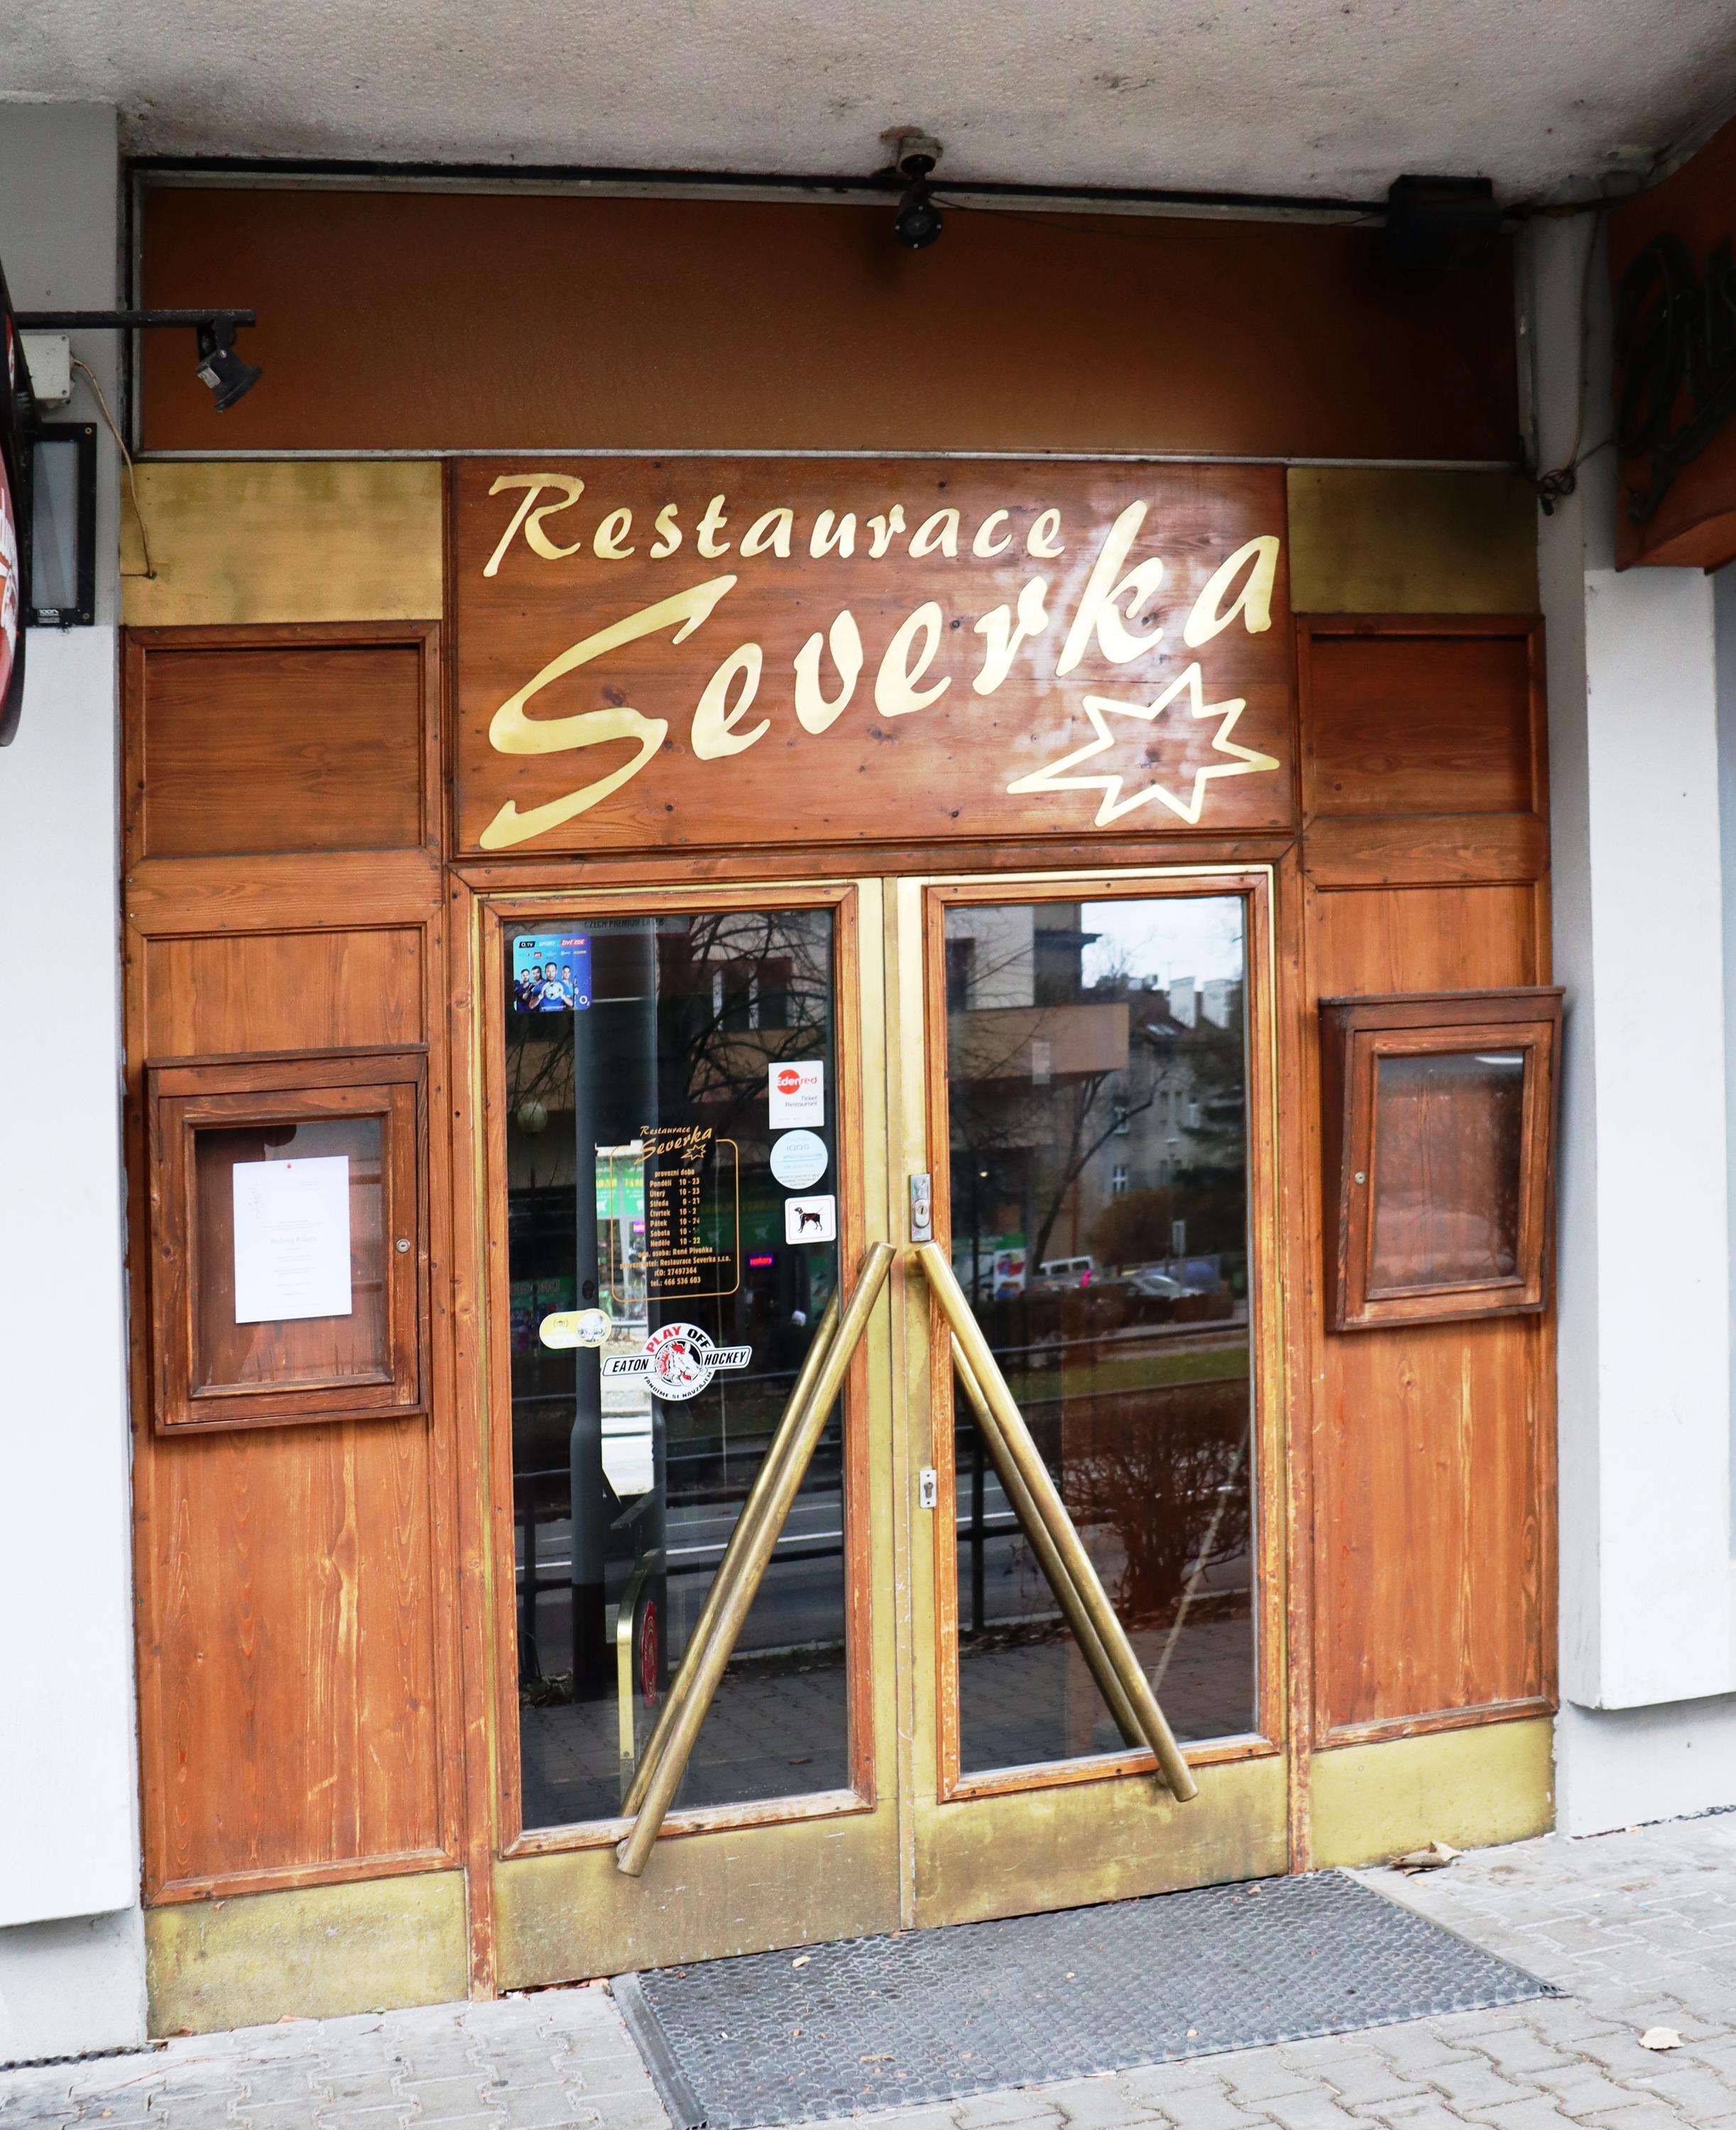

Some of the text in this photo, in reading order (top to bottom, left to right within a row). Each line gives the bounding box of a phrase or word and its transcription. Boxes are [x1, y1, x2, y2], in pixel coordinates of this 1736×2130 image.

[483, 474, 1066, 578] Restaurace
[478, 499, 1280, 851] Severka
[777, 1076, 817, 1086] Edenred
[640, 1125, 691, 1137] Restaurace
[633, 1125, 713, 1165] Severka
[660, 1257, 692, 1267] Restaurace
[692, 1255, 716, 1264] Severka
[645, 1325, 711, 1353] PLAY OFF
[704, 1351, 747, 1365] HOCKEY
[612, 1359, 650, 1372] EATON
